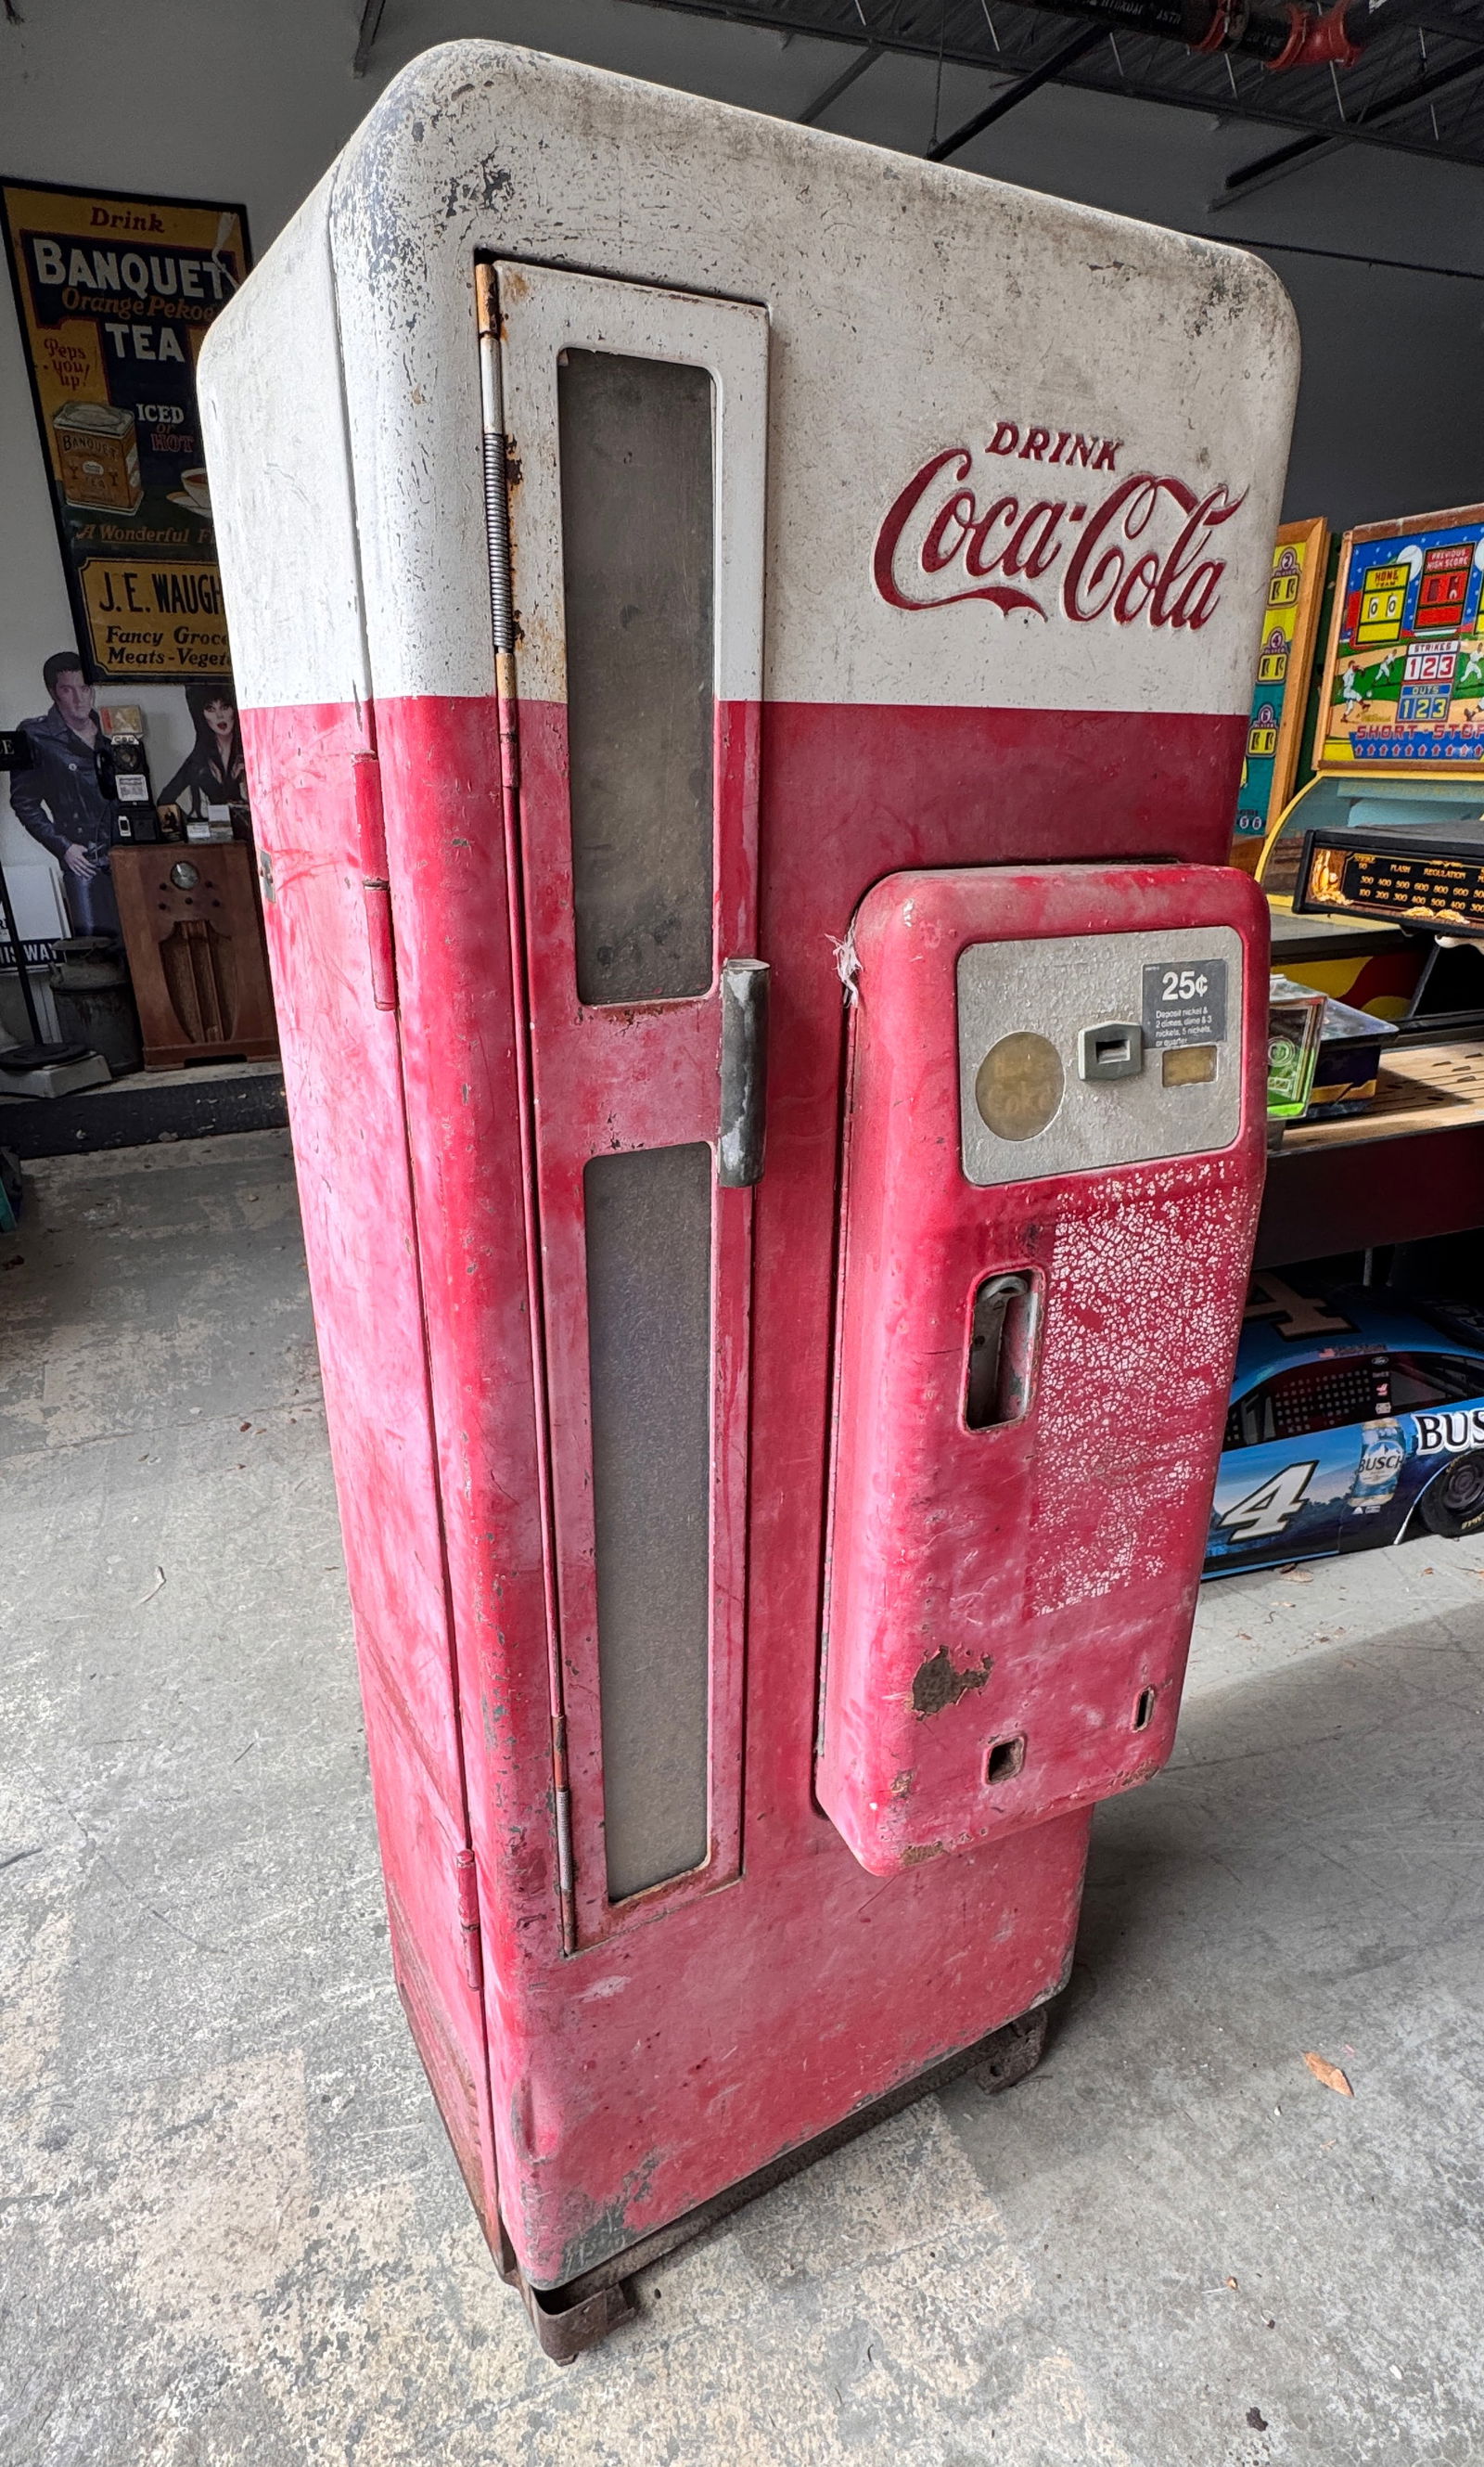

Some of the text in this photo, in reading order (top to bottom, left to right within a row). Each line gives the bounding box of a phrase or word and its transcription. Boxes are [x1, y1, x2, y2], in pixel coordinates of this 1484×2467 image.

[90, 207, 165, 233] Drink
[33, 238, 225, 299] BANQUET
[61, 288, 144, 320] Orange
[44, 338, 86, 361] Peps
[105, 322, 186, 363] TEA
[52, 358, 83, 377] you
[136, 404, 185, 424] ICED
[156, 423, 175, 434] or
[150, 432, 195, 453] HOT
[985, 421, 1123, 470] DRINK
[100, 523, 190, 543] Wonderful
[1444, 557, 1468, 568] SCORE
[1375, 570, 1399, 582] HOME
[98, 572, 122, 612] J.
[122, 572, 150, 612] E.
[106, 625, 163, 647] Fancy
[1414, 642, 1452, 653] STRIKES
[1412, 686, 1439, 696] OUTS
[1389, 864, 1412, 874] FLASH
[1423, 867, 1466, 880] REGULATION
[1377, 878, 1392, 887] 400
[1414, 882, 1429, 893] 600
[1452, 887, 1469, 897] 600
[1359, 888, 1371, 897] 100
[1375, 891, 1389, 900] 200
[1450, 900, 1466, 910] 400
[1161, 970, 1209, 1001] 25¢
[1156, 1006, 1209, 1020] Deposit nickel &
[1156, 1021, 1161, 1029] 2
[1160, 1019, 1183, 1028] dimes,
[1183, 1017, 1201, 1025] dime
[1207, 1015, 1213, 1024] 3
[1182, 1026, 1187, 1035] 5
[1156, 1036, 1188, 1047] or quarter
[1357, 1455, 1403, 1474] BUSCH
[1220, 1460, 1319, 1543] 4
